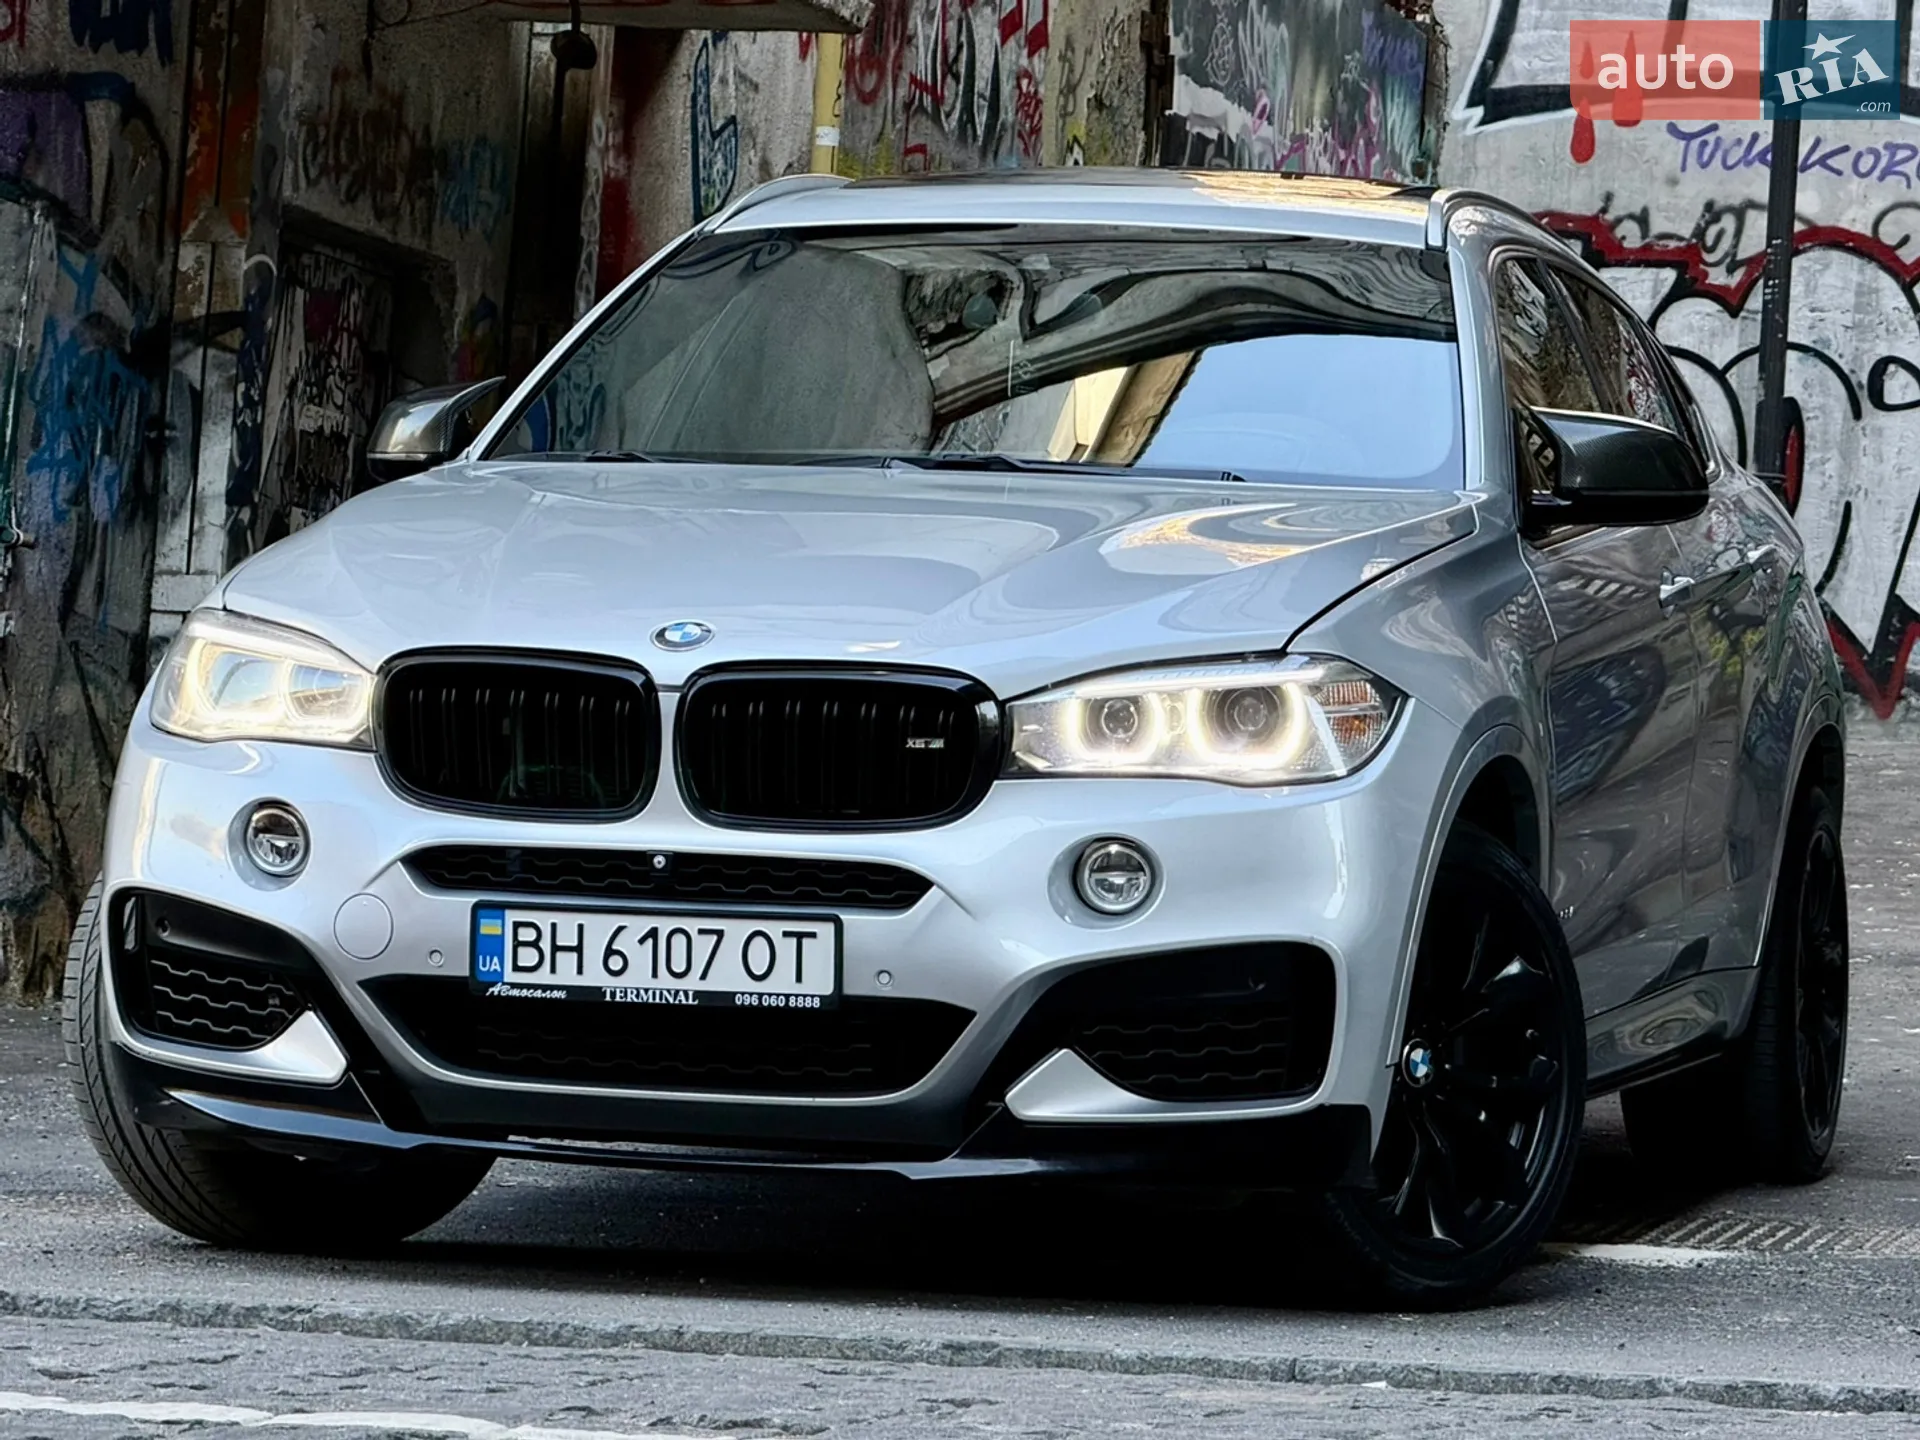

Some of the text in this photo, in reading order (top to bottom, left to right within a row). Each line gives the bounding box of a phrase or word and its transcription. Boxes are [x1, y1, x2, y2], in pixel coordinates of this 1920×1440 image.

[511, 920, 818, 984] BH 6107 OT
[478, 955, 502, 973] UA
[602, 987, 699, 1005] TERMINAL
[735, 993, 821, 1009] 096 060 8888
